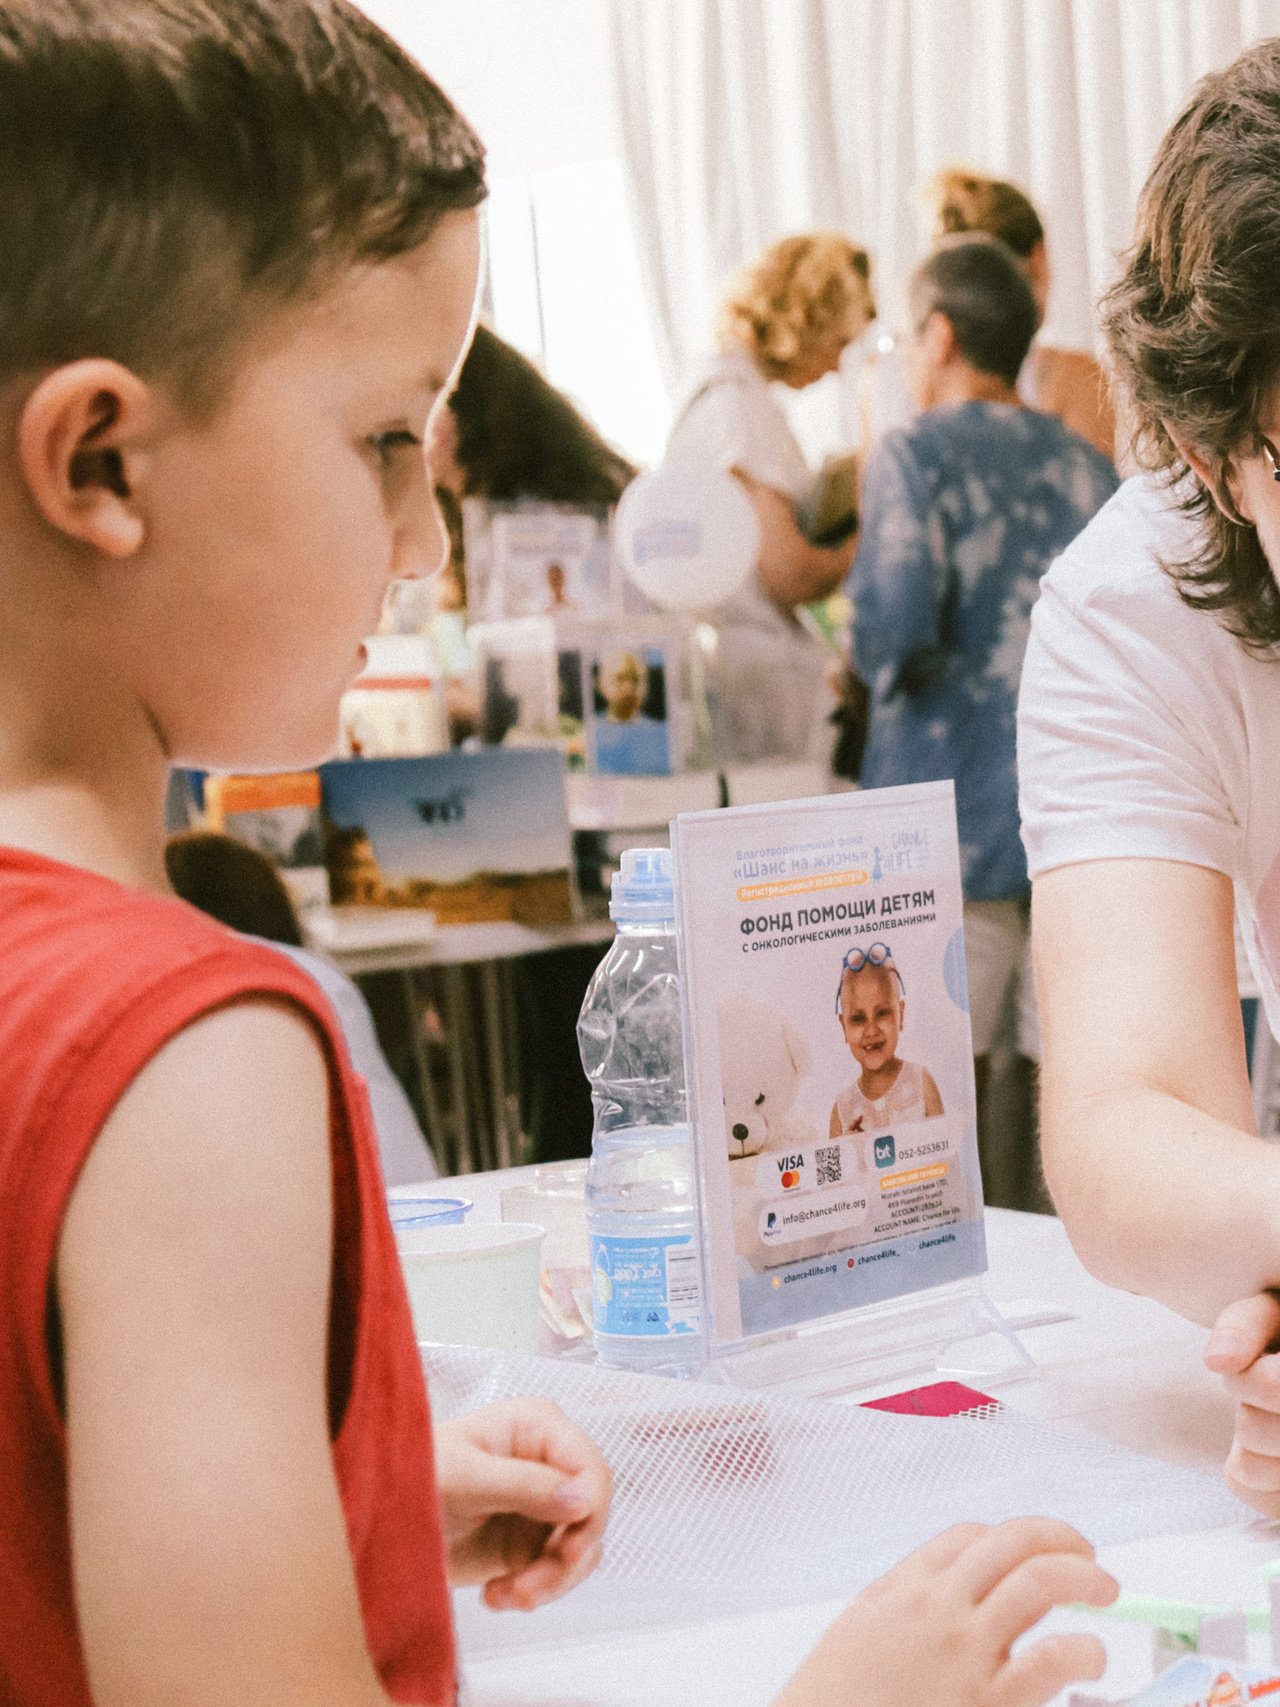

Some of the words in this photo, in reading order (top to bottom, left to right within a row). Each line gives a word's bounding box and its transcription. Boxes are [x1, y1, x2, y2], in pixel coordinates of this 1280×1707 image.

[791, 859, 809, 870] на
[740, 912, 793, 935] ФОНД
[797, 899, 876, 927] ПОМОЩИ
[881, 890, 935, 915] ДЕТЯМ
[742, 943, 749, 953] С
[751, 927, 851, 952] ОНКОЛОГИЧЕСКИМИ
[853, 912, 936, 935] ЗАБОЛЕВАНИЯМИ
[875, 1144, 892, 1160] bit
[899, 1140, 949, 1160] 052-5253631
[776, 1154, 804, 1172] VISA
[782, 1199, 866, 1225] info@chance4life.org
[874, 1221, 902, 1233] ACCOUNT
[919, 1233, 956, 1250] chance4life
[783, 1264, 837, 1284] chance4life.org
